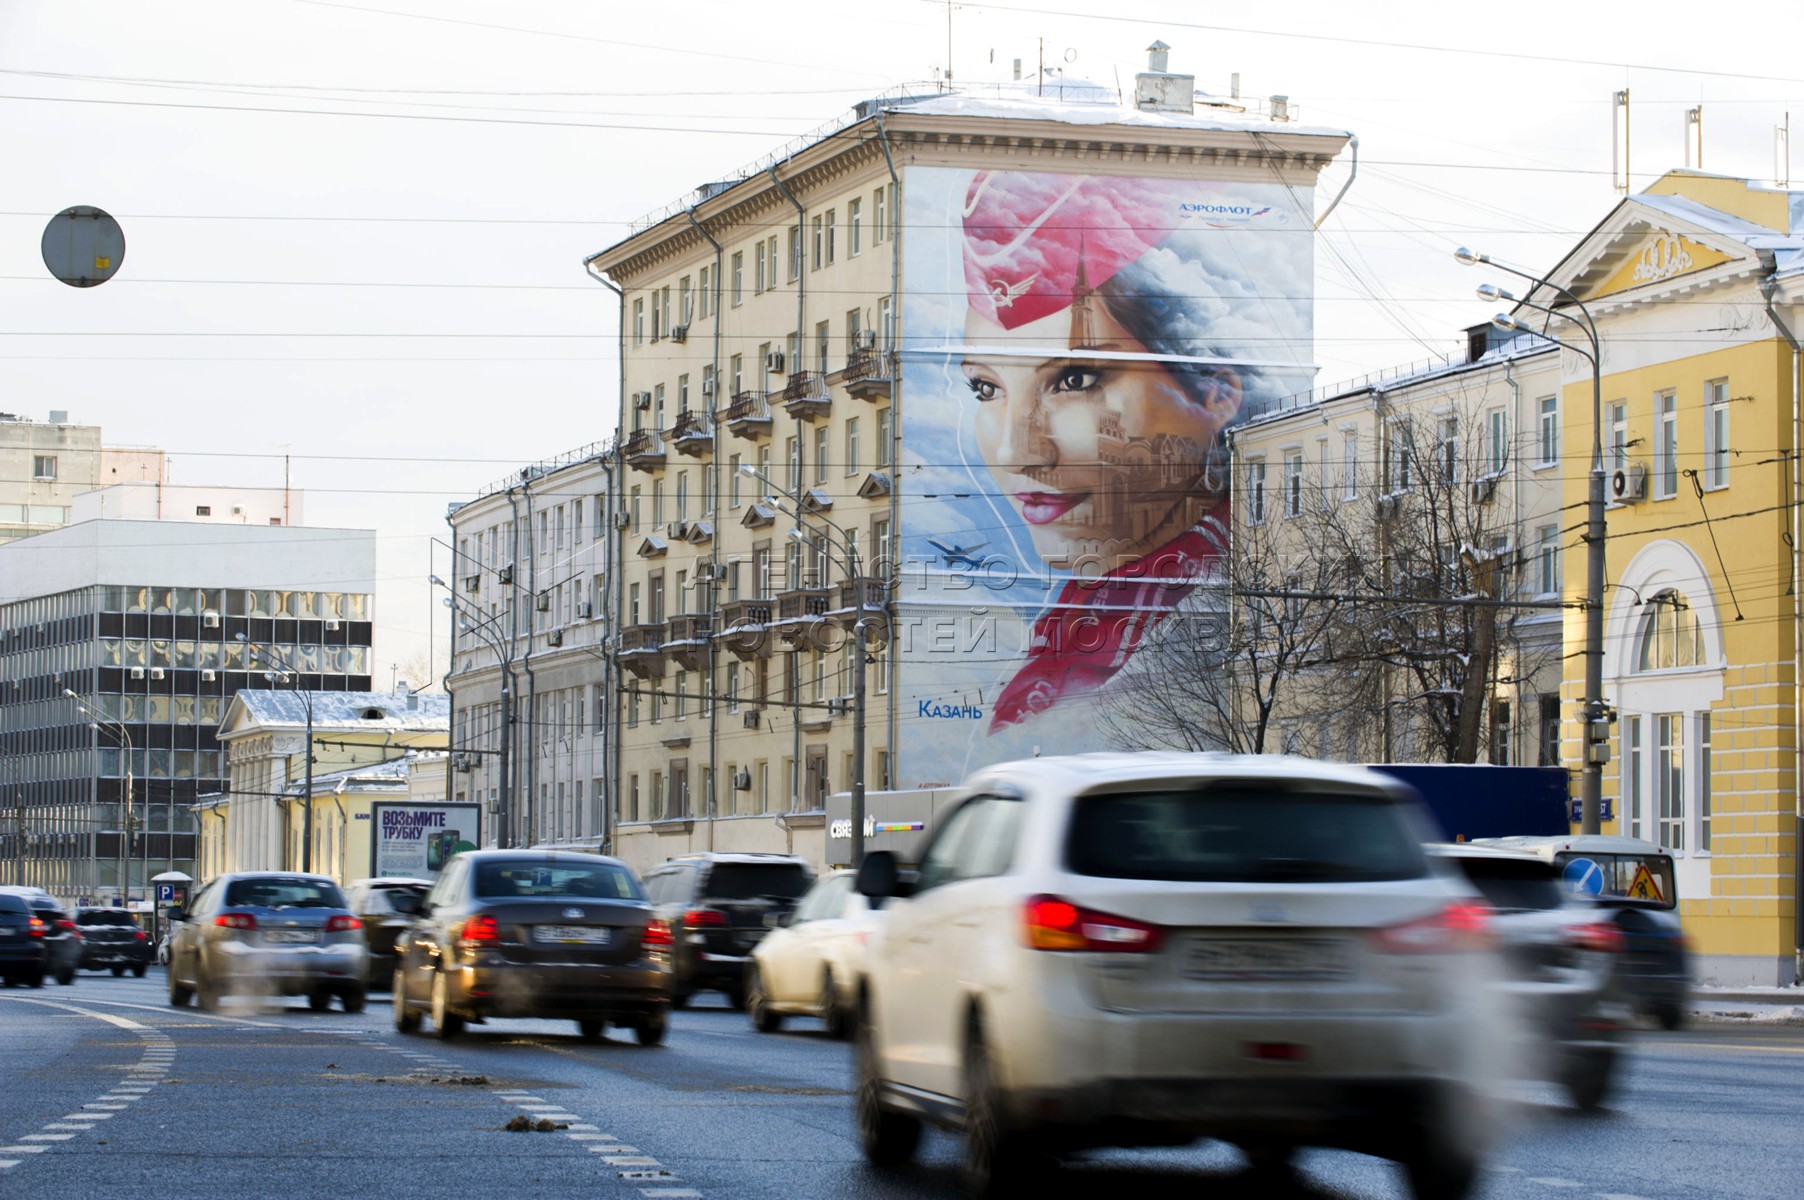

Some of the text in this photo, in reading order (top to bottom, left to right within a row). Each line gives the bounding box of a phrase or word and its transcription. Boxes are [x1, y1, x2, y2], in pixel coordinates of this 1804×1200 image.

[1179, 203, 1253, 215] АЭРОФЛОТ
[382, 810, 446, 827] ВОЗЬМИТЕ
[382, 826, 423, 840] ТРУБКУ
[161, 886, 170, 899] P
